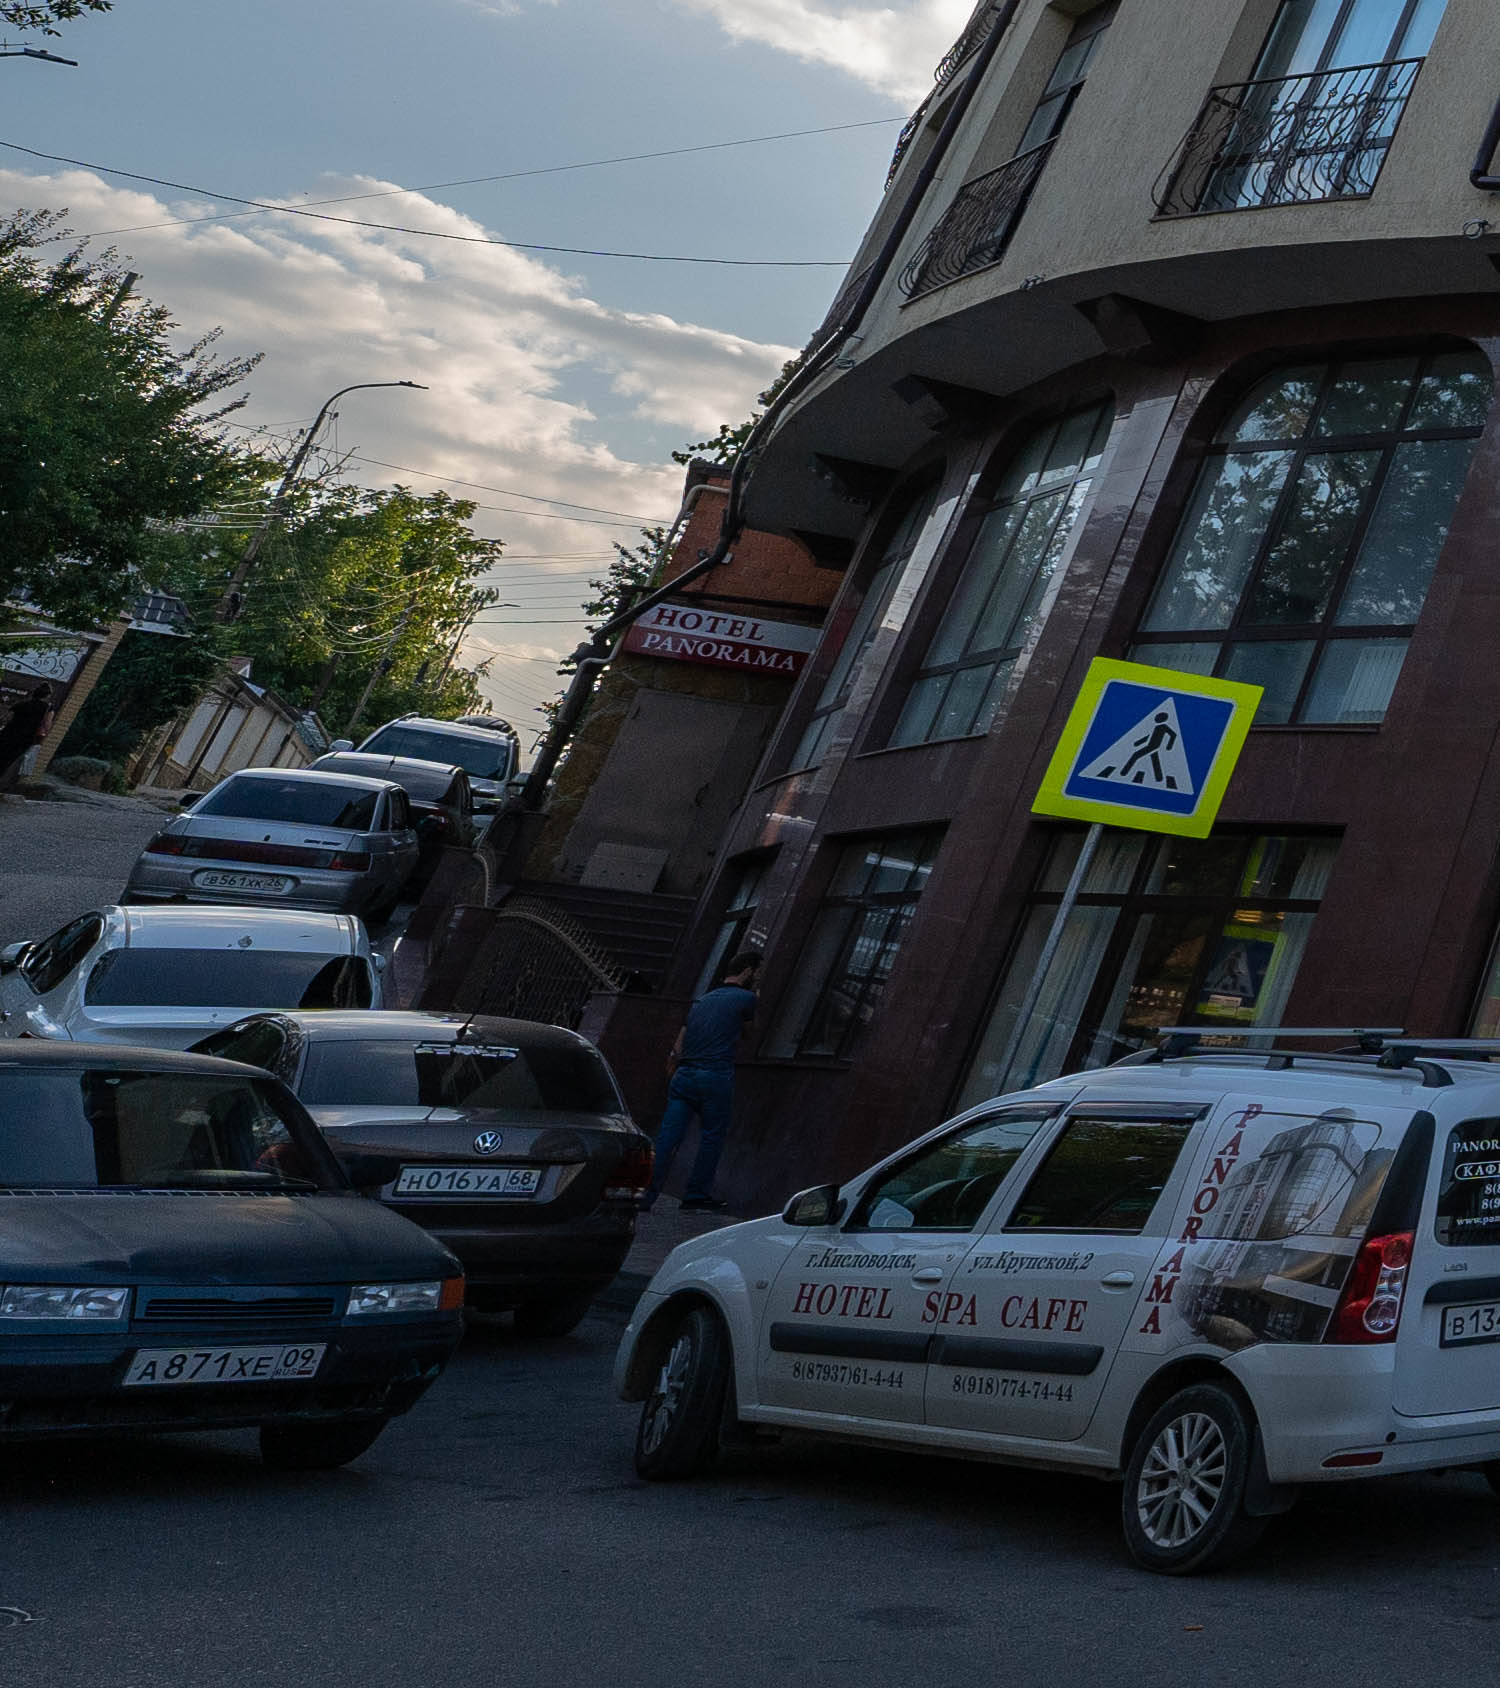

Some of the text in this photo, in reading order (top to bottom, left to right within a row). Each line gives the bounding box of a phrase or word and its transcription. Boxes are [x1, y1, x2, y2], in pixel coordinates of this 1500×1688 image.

[652, 607, 765, 641] HOTEL
[640, 632, 796, 672] PANORAMA
[407, 1171, 533, 1190] Н016УА 68
[1140, 1103, 1263, 1334] PANORAMA
[792, 1282, 1089, 1333] HOTEL SPA CAFE
[138, 1348, 315, 1380] А871ХЕ 09
[274, 1367, 298, 1377] RUS
[792, 1362, 1074, 1402] 8(87937)61-4-44 8(918)774-74-44
